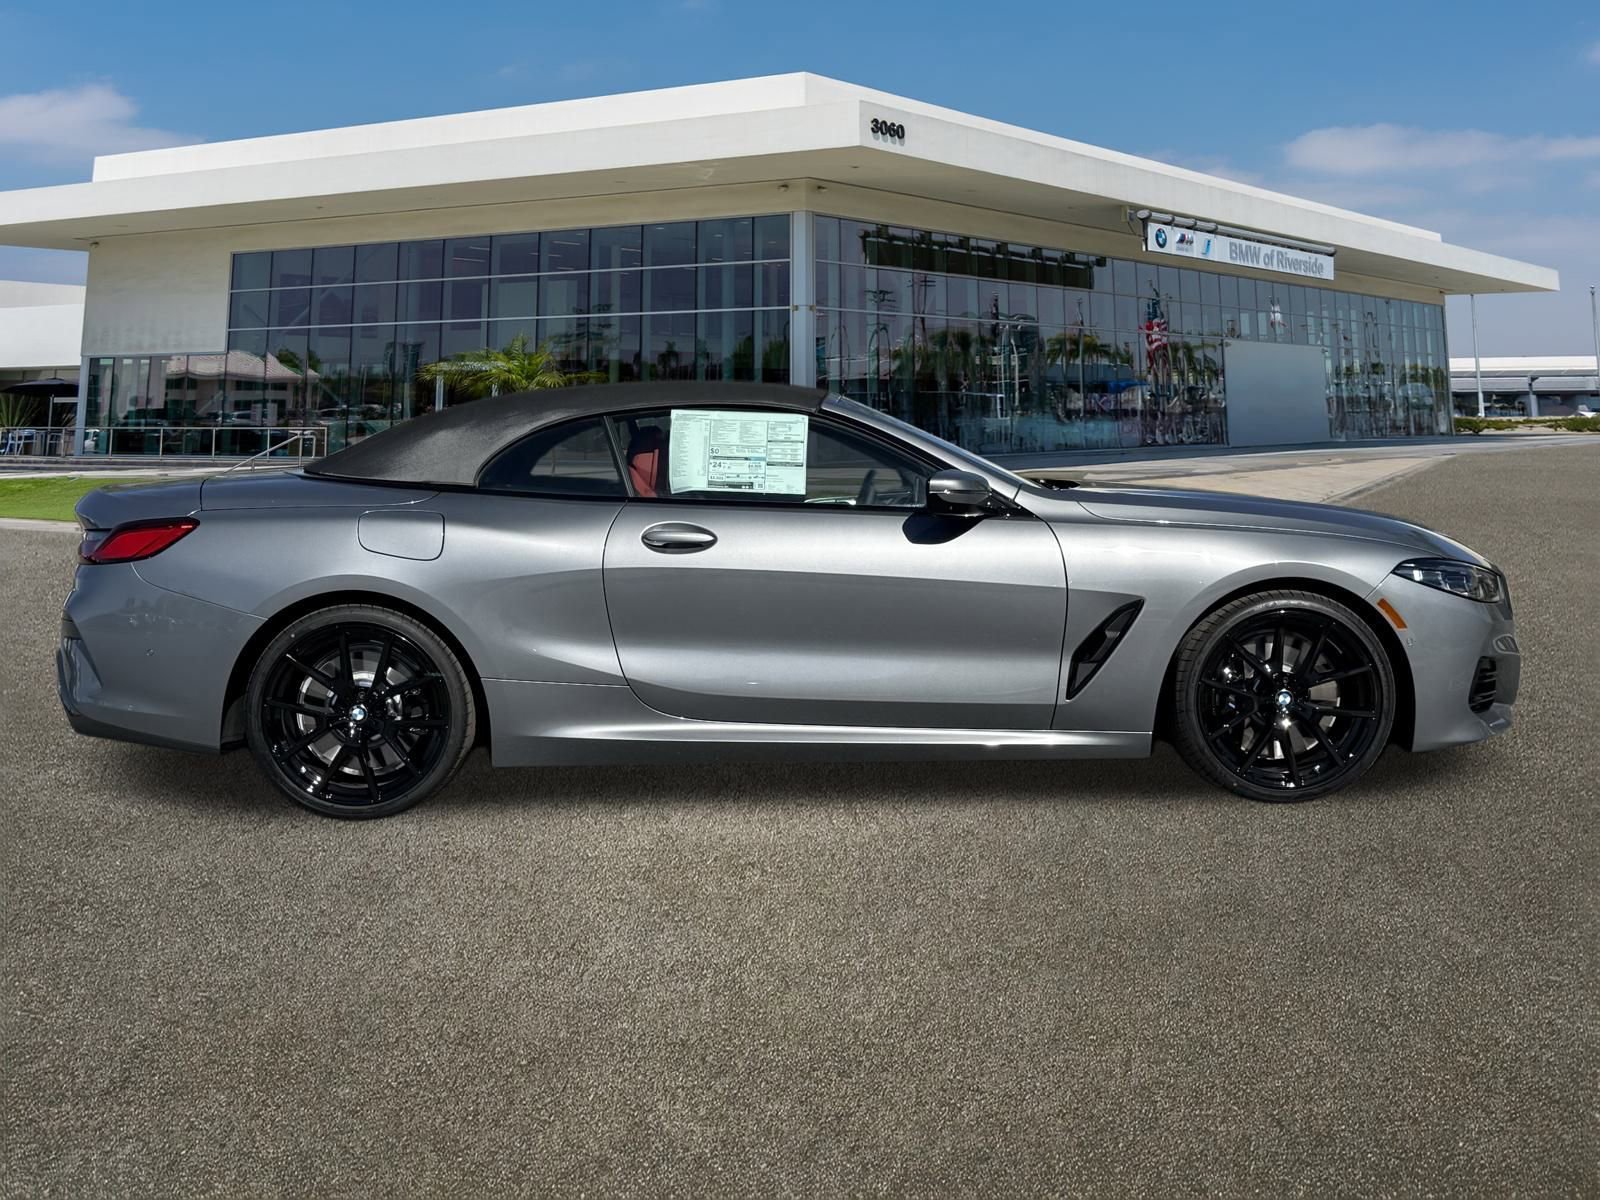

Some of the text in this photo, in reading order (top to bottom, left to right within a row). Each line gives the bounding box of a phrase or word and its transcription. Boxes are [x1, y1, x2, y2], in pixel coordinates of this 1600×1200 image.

[870, 117, 905, 139] 3060
[1229, 241, 1324, 275] BMW of Riverside
